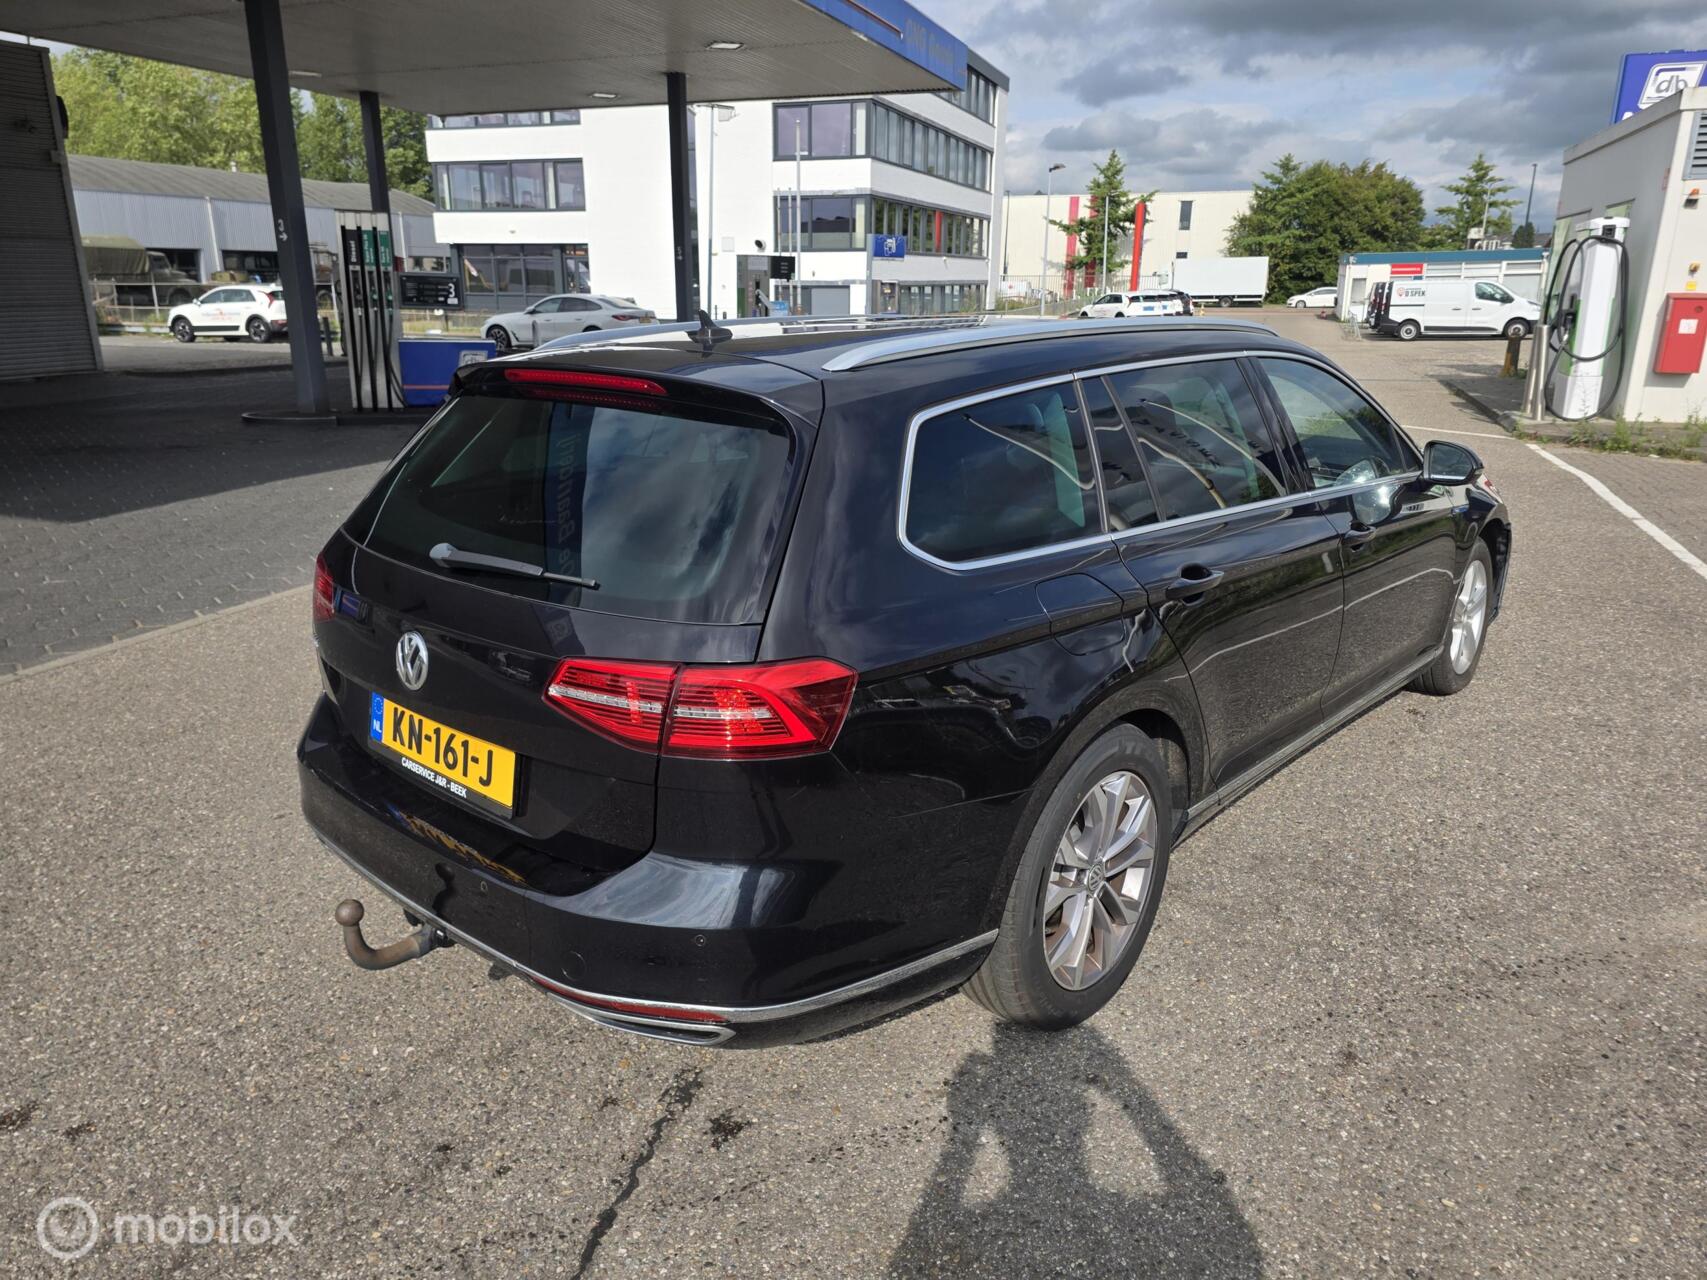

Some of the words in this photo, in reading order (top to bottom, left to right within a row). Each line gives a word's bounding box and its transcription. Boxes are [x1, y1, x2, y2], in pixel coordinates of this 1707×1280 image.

[1655, 75, 1688, 94] db
[349, 240, 357, 262] Diesel
[447, 283, 455, 297] 3
[373, 719, 382, 733] NL
[392, 706, 494, 787] KN-161-J
[401, 757, 436, 783] CARSERVICE
[450, 782, 468, 799] BEEK
